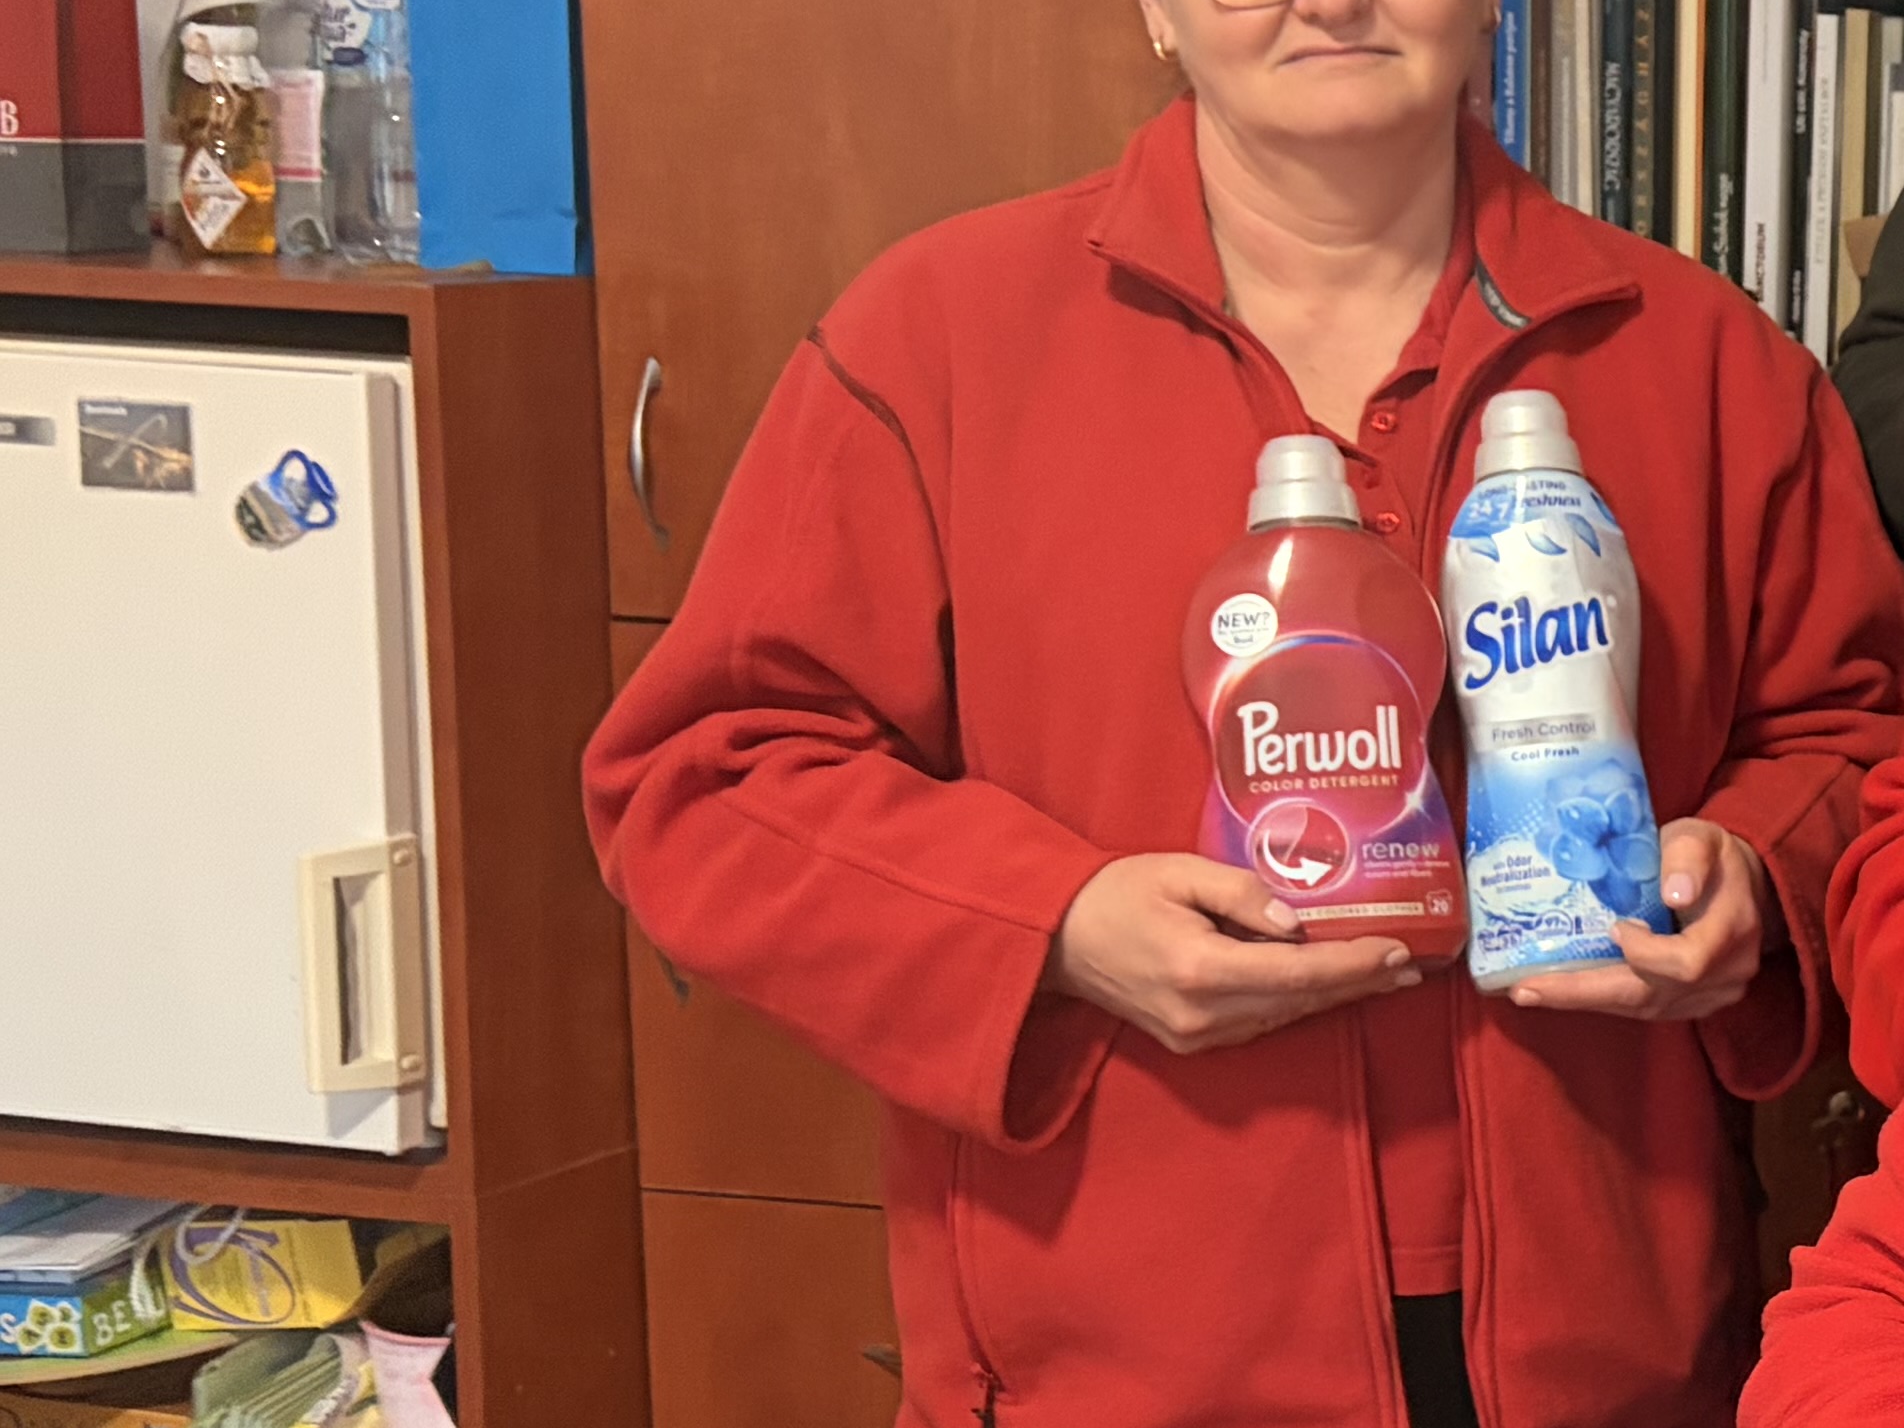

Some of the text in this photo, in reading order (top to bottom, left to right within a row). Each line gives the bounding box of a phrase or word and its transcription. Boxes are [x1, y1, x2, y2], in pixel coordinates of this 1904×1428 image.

[1218, 612, 1270, 628] NEW?
[1464, 596, 1609, 690] Silan
[1236, 701, 1402, 776] Perwoll
[1492, 720, 1597, 741] Fresh Control
[1511, 746, 1580, 762] Cool Fresh
[1249, 774, 1400, 793] COLOR DETERGENT
[1362, 842, 1441, 860] renew
